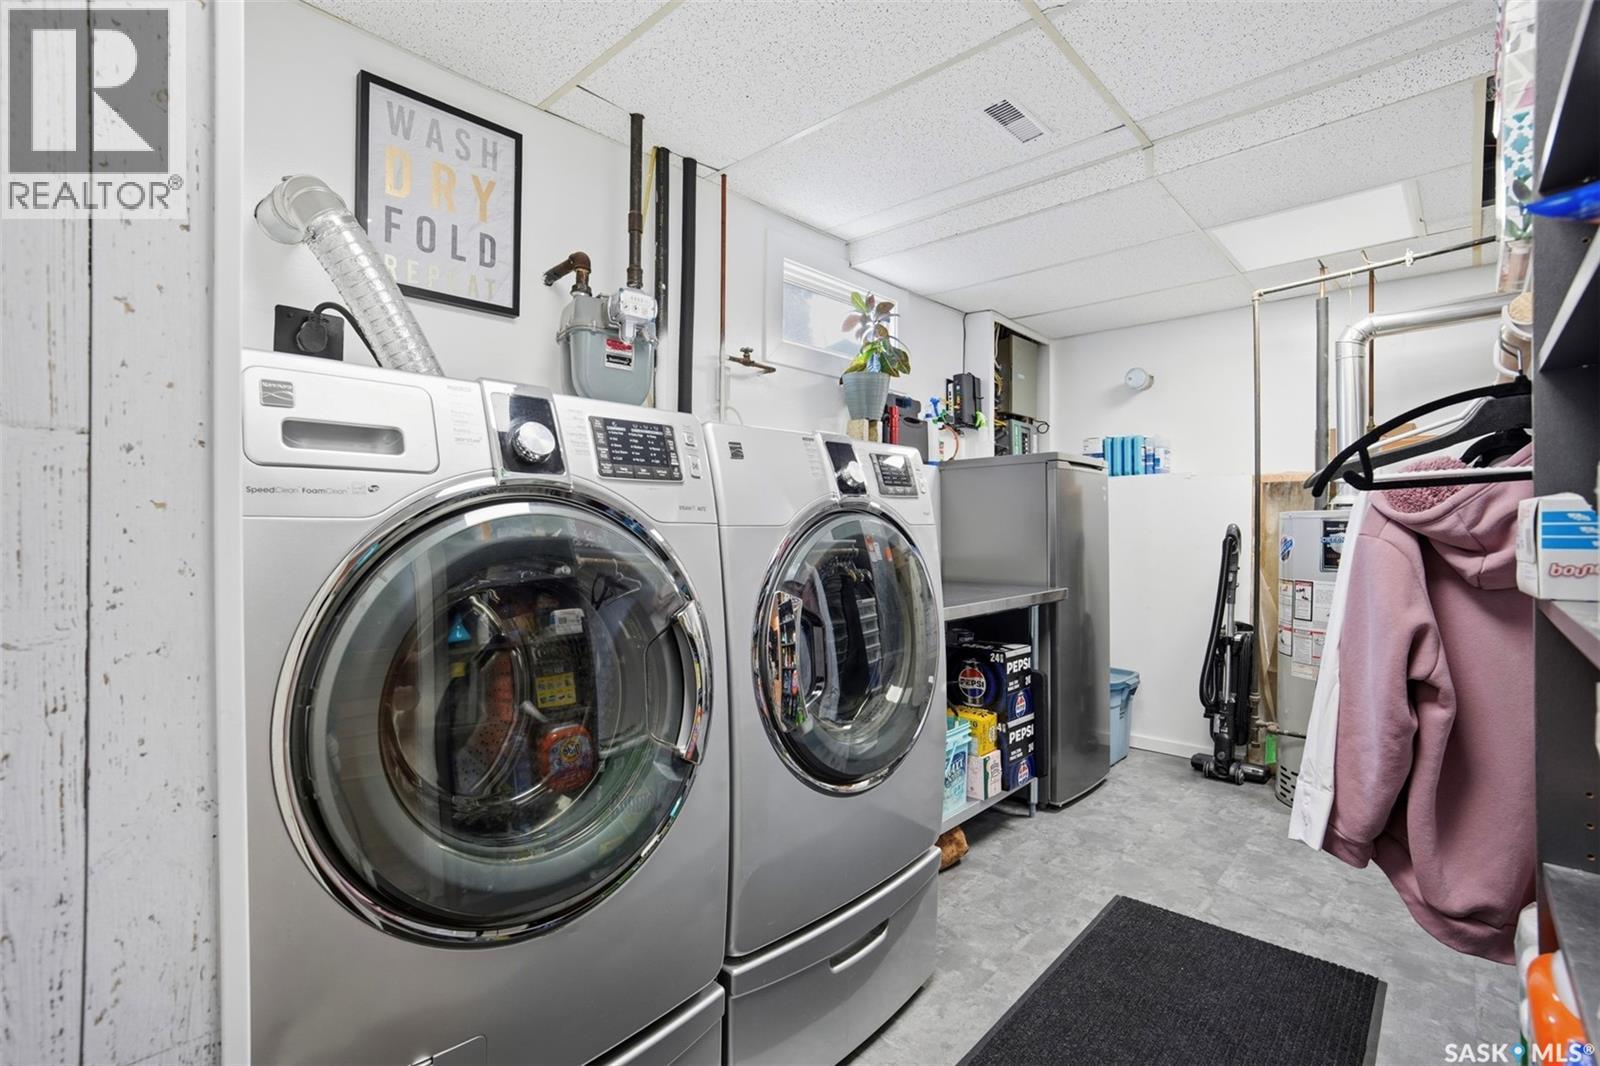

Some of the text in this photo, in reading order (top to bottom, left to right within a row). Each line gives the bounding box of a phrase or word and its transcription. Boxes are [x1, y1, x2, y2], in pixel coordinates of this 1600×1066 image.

[386, 100, 498, 172] WASH
[384, 144, 496, 224] DRY
[384, 205, 496, 268] FOLD
[960, 678, 985, 688] PEPSI
[1006, 657, 1031, 675] PEPSI
[1009, 723, 1034, 744] PEPSI
